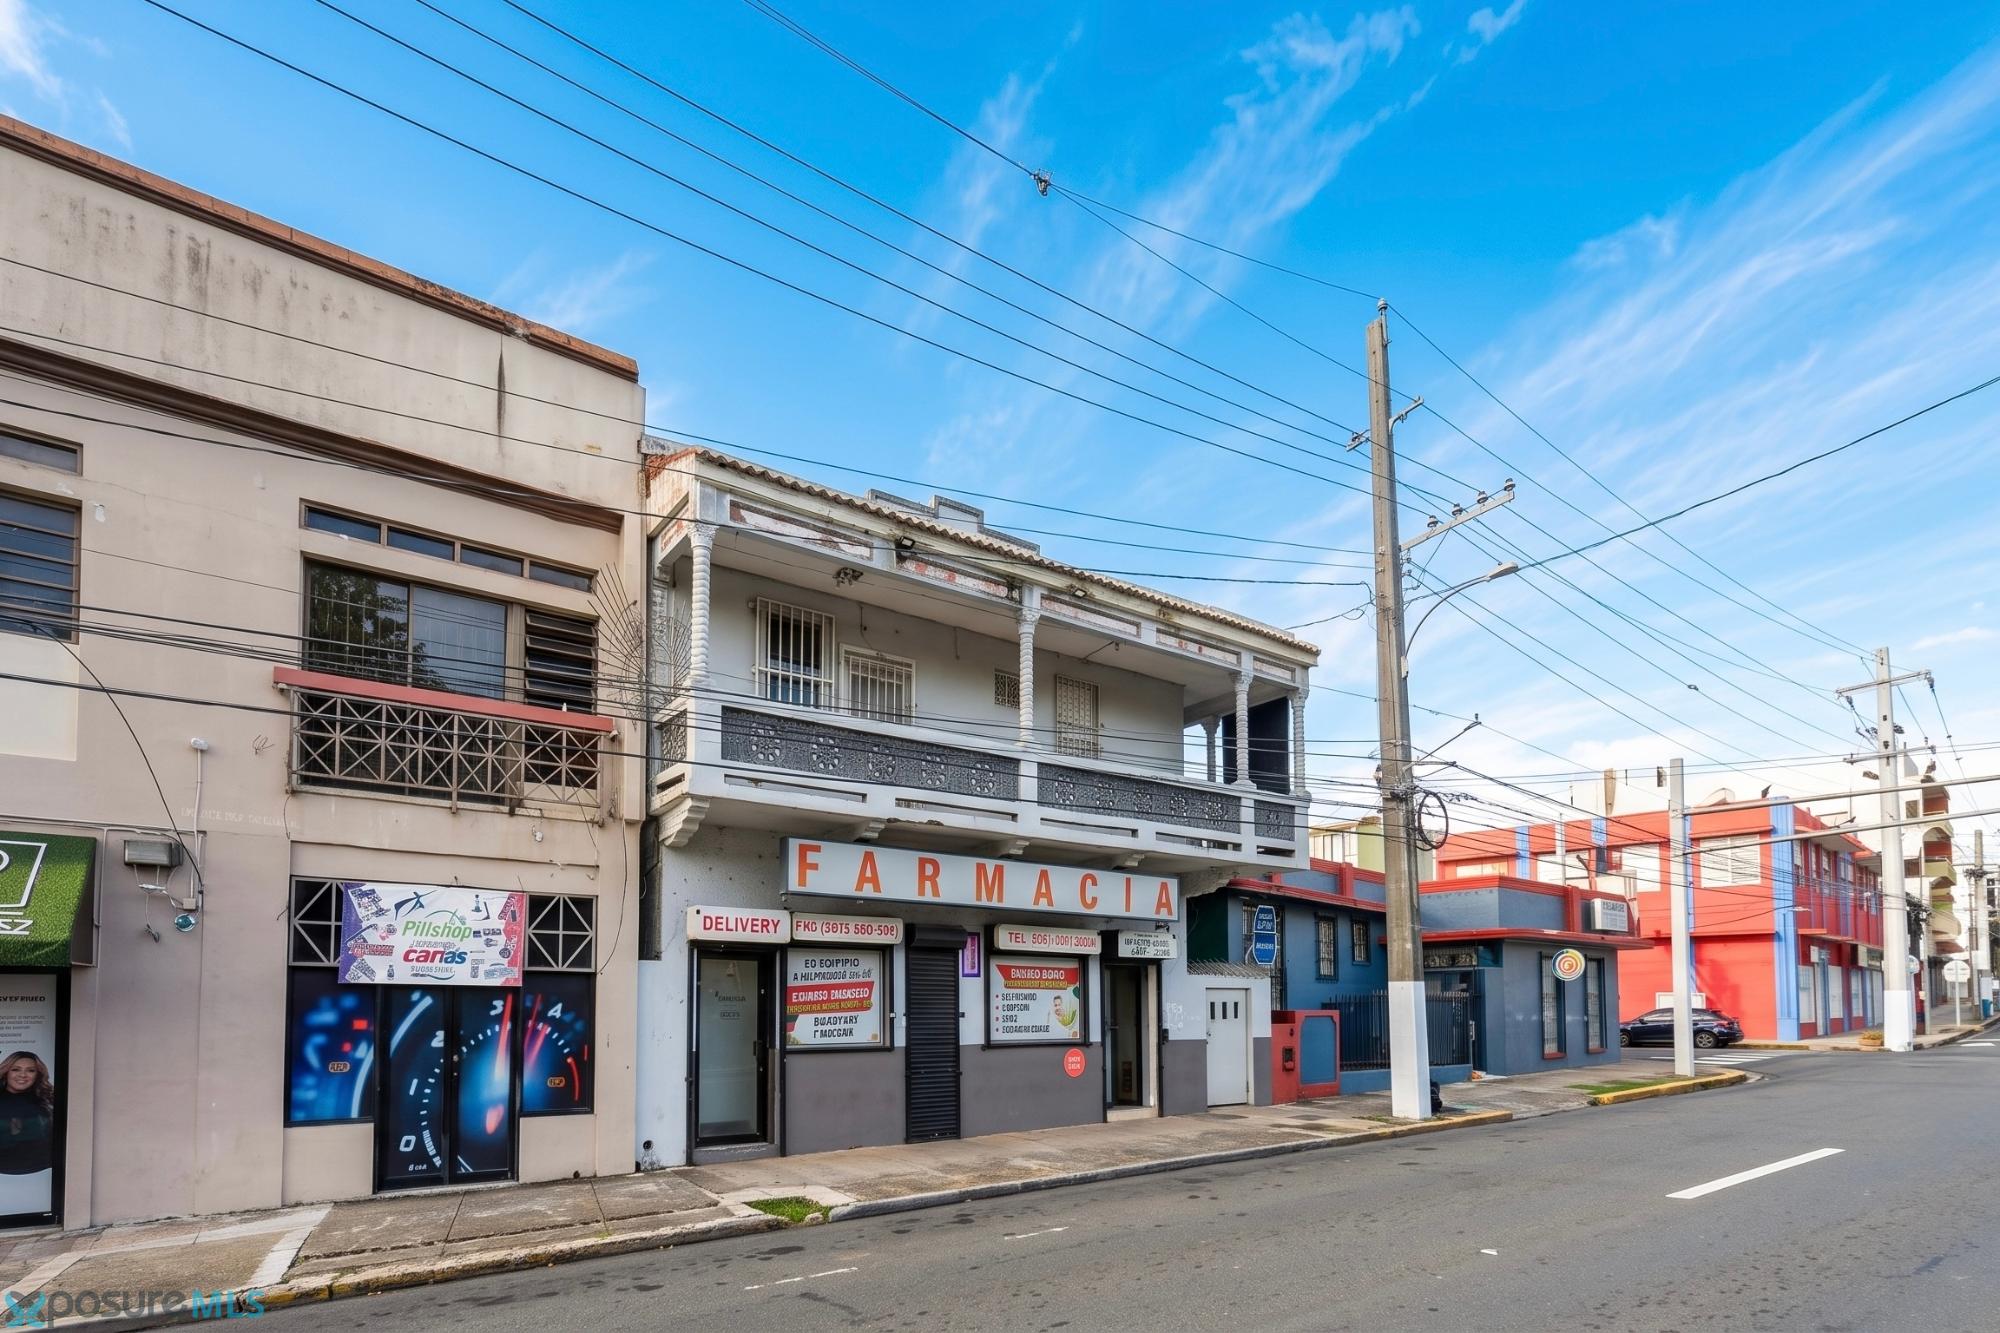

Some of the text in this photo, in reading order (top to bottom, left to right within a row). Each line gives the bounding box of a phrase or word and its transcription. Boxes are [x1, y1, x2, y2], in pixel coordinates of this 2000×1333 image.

[796, 843, 1174, 917] FARMACIA
[402, 920, 472, 942] Pillshop
[703, 915, 781, 934] DELIVERY
[1008, 932, 1026, 944] TEL
[489, 1000, 504, 1016] 3
[547, 1002, 563, 1019] 4
[430, 1030, 445, 1048] 2
[399, 1135, 416, 1152] 0
